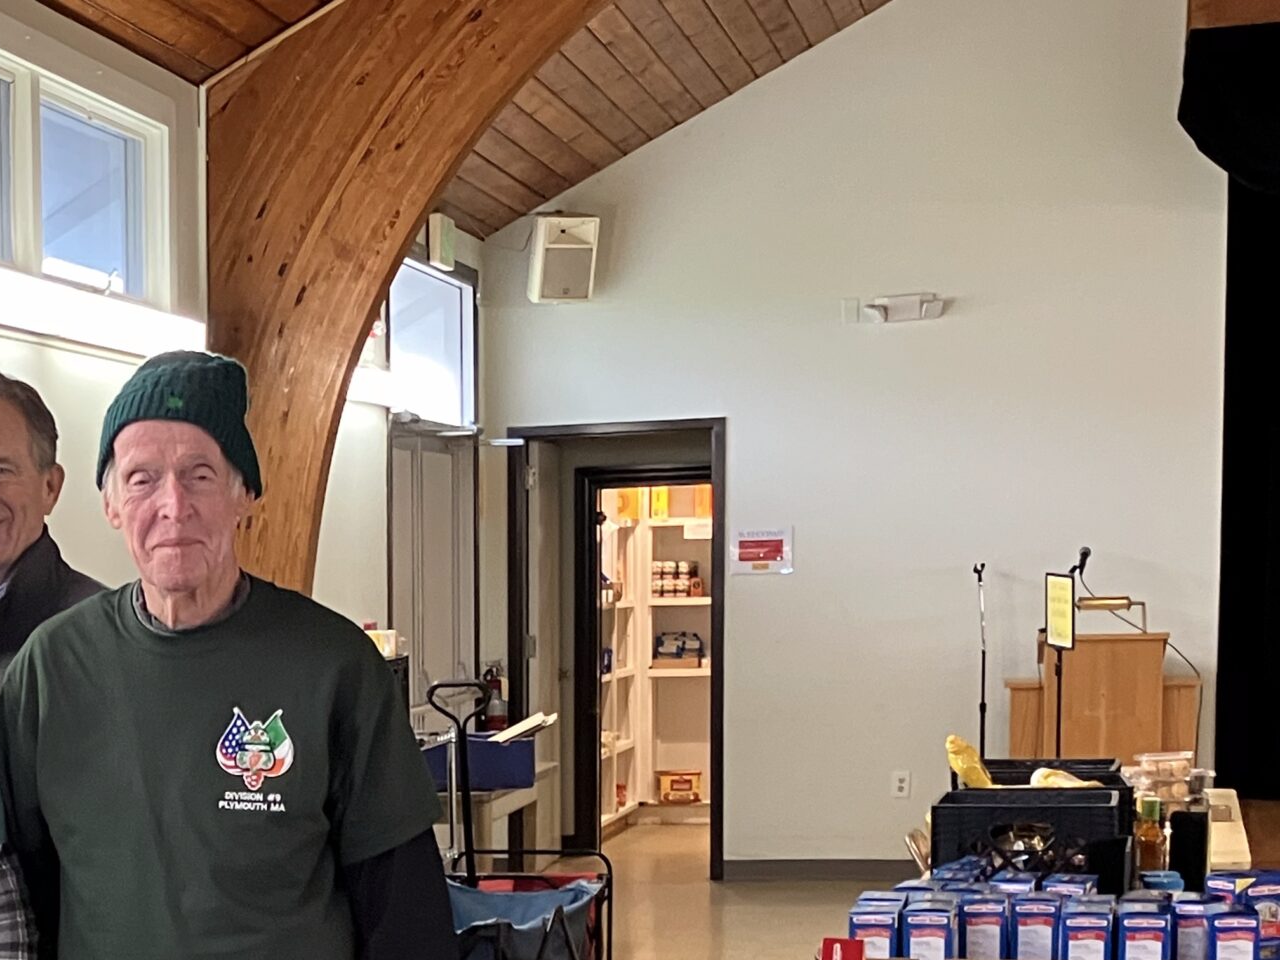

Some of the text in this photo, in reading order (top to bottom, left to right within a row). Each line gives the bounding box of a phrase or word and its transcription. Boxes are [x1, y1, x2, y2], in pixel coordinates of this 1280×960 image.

[224, 791, 264, 801] DIVISION
[218, 800, 286, 812] PLYMOUTH MA
